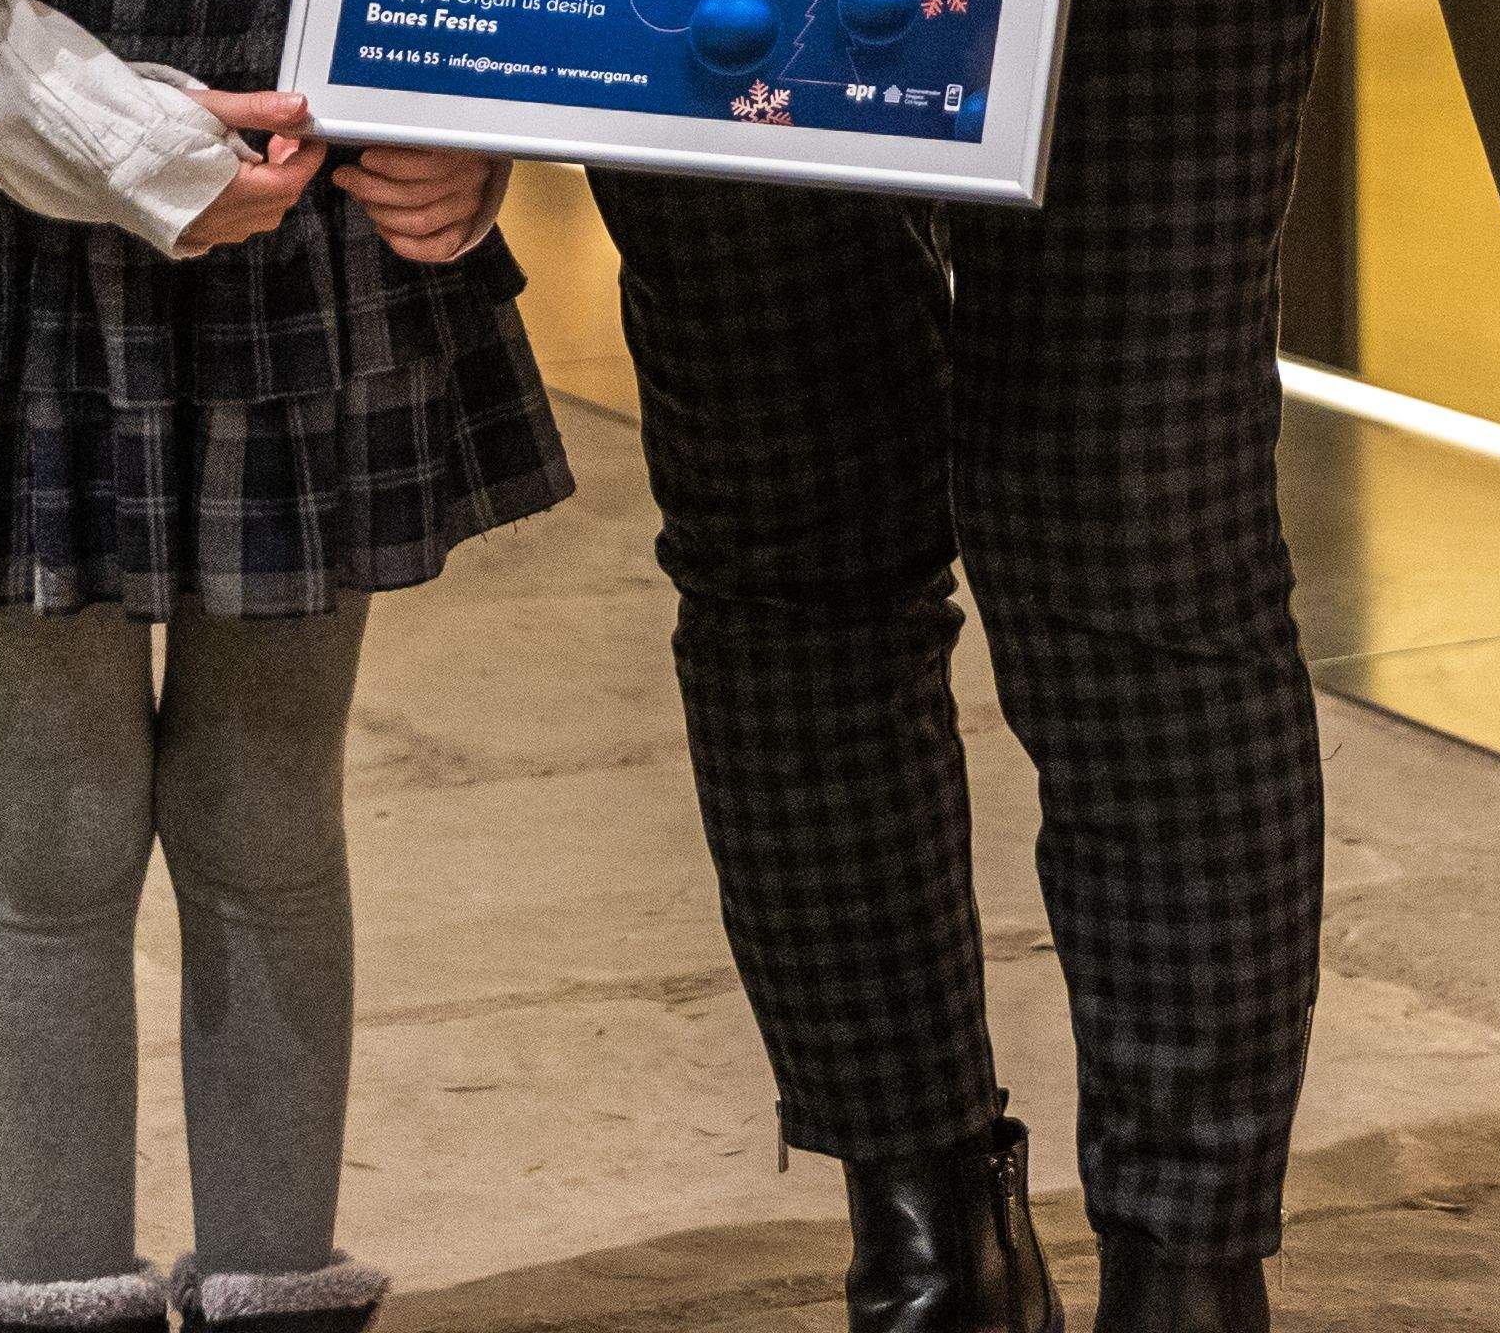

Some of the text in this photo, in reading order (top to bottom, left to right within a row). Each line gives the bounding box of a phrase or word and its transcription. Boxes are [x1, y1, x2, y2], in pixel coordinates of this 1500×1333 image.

[366, 3, 498, 37] Bones Festes
[359, 46, 648, 85] 935 44 16 55 info@organ.es www.organ.es
[846, 84, 876, 101] apr
